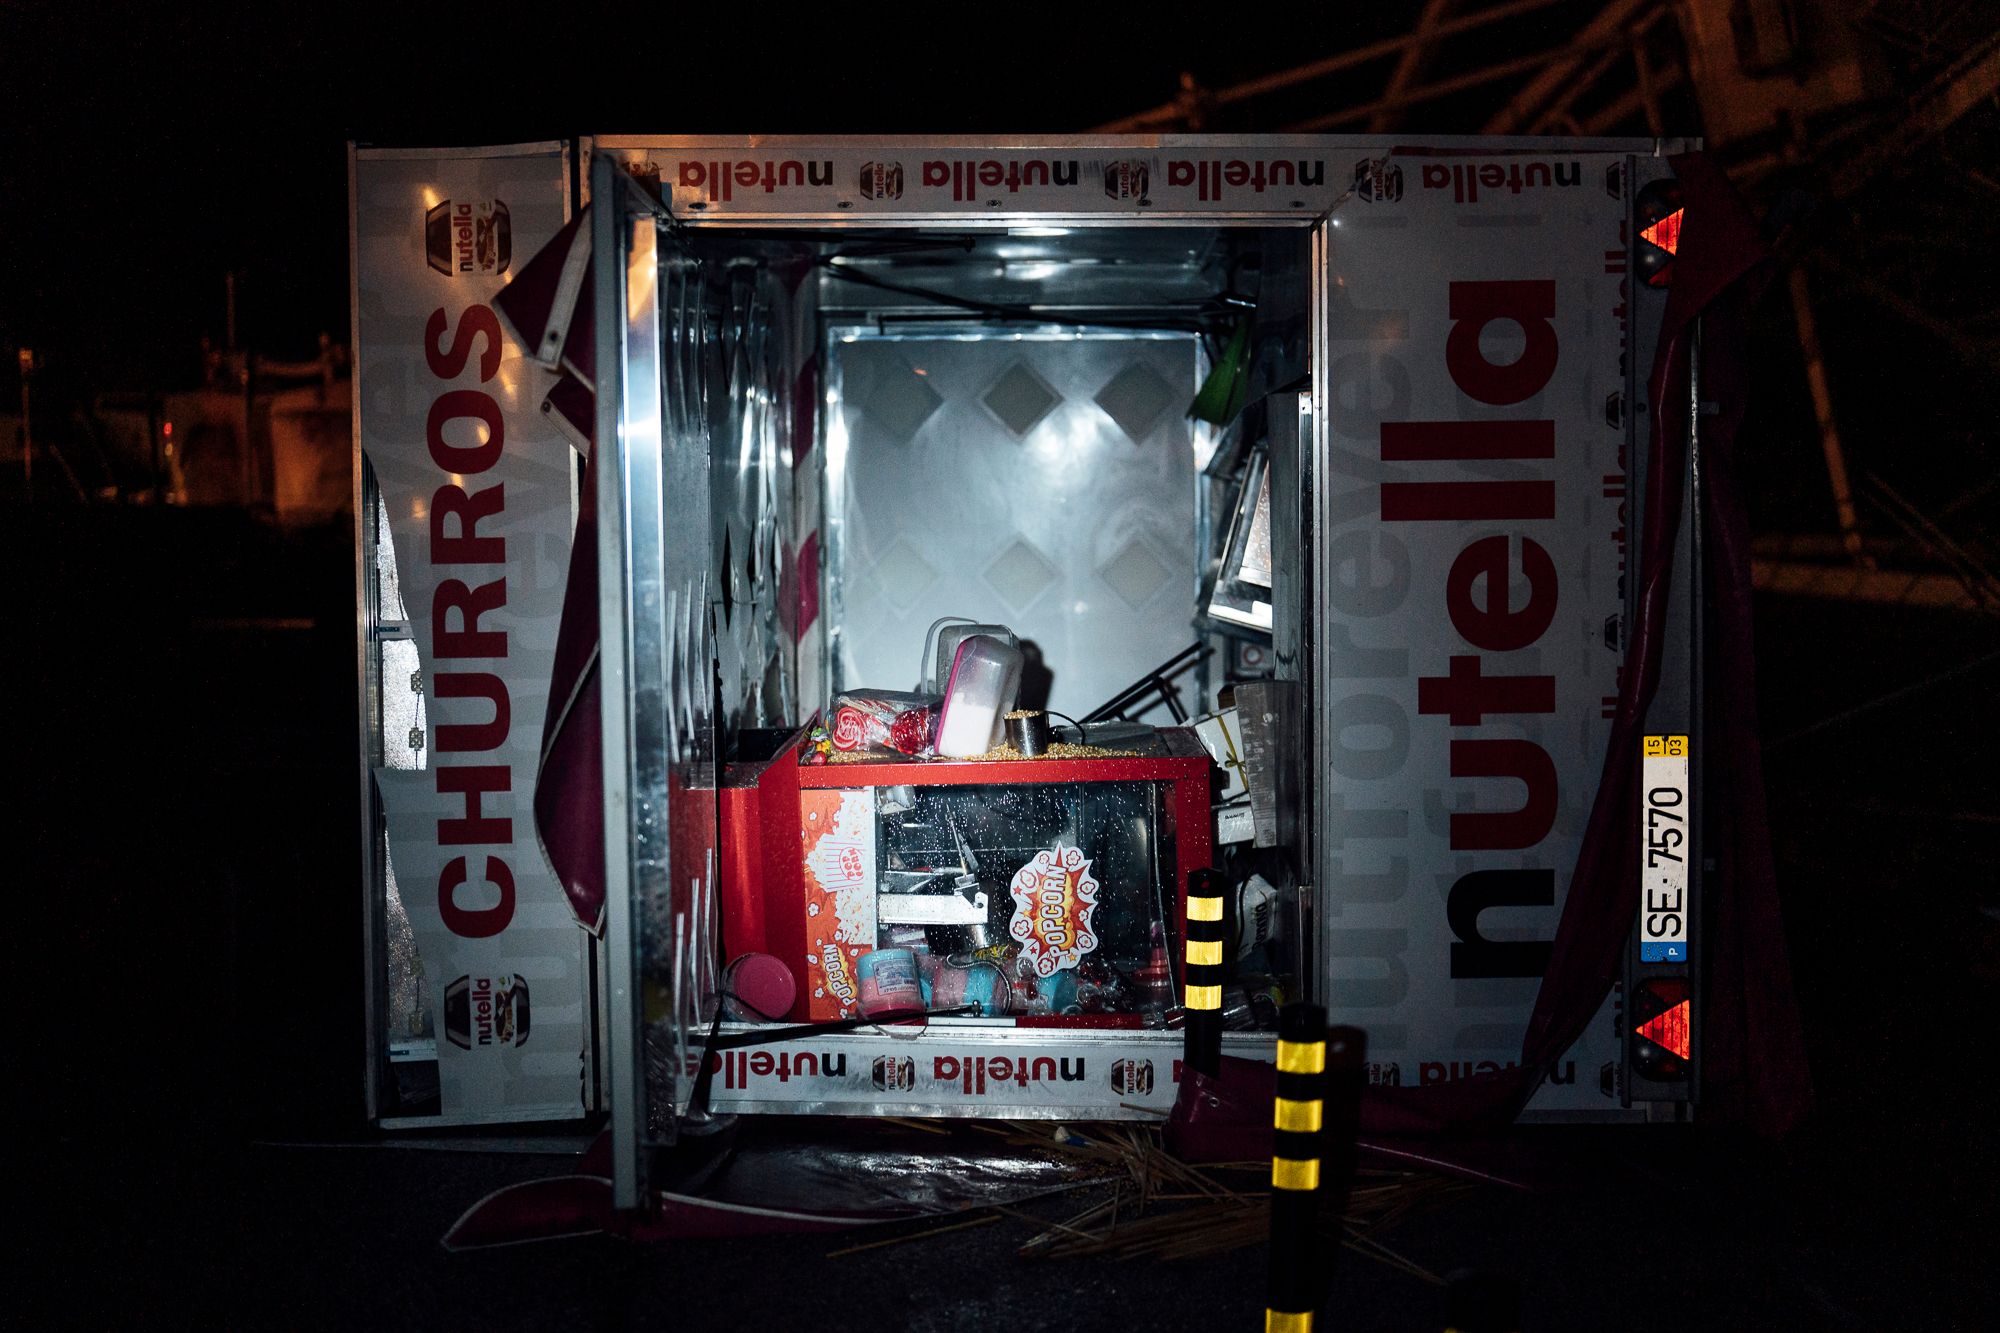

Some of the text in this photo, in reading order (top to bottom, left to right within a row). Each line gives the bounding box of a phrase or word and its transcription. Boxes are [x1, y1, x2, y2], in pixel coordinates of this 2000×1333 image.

[679, 160, 834, 202] nutella
[873, 163, 885, 199] nutella
[922, 160, 1078, 202] nutella
[1118, 162, 1129, 198] nutella
[1168, 160, 1324, 202] nutella
[1422, 162, 1581, 203] nutella
[453, 203, 474, 272] nutella
[425, 304, 516, 938] CHURROS
[1380, 280, 1558, 979] nutella
[1648, 739, 1660, 756] 15
[1669, 739, 1682, 756] 03
[1648, 787, 1683, 868] 7570
[1040, 863, 1070, 958] POPCORN
[1668, 947, 1679, 956] P
[824, 943, 857, 1007] POPCORN
[472, 978, 492, 1046] nutella
[886, 1056, 896, 1091] nutella
[933, 1056, 1085, 1095] nutella
[1125, 1060, 1135, 1094] nutella
